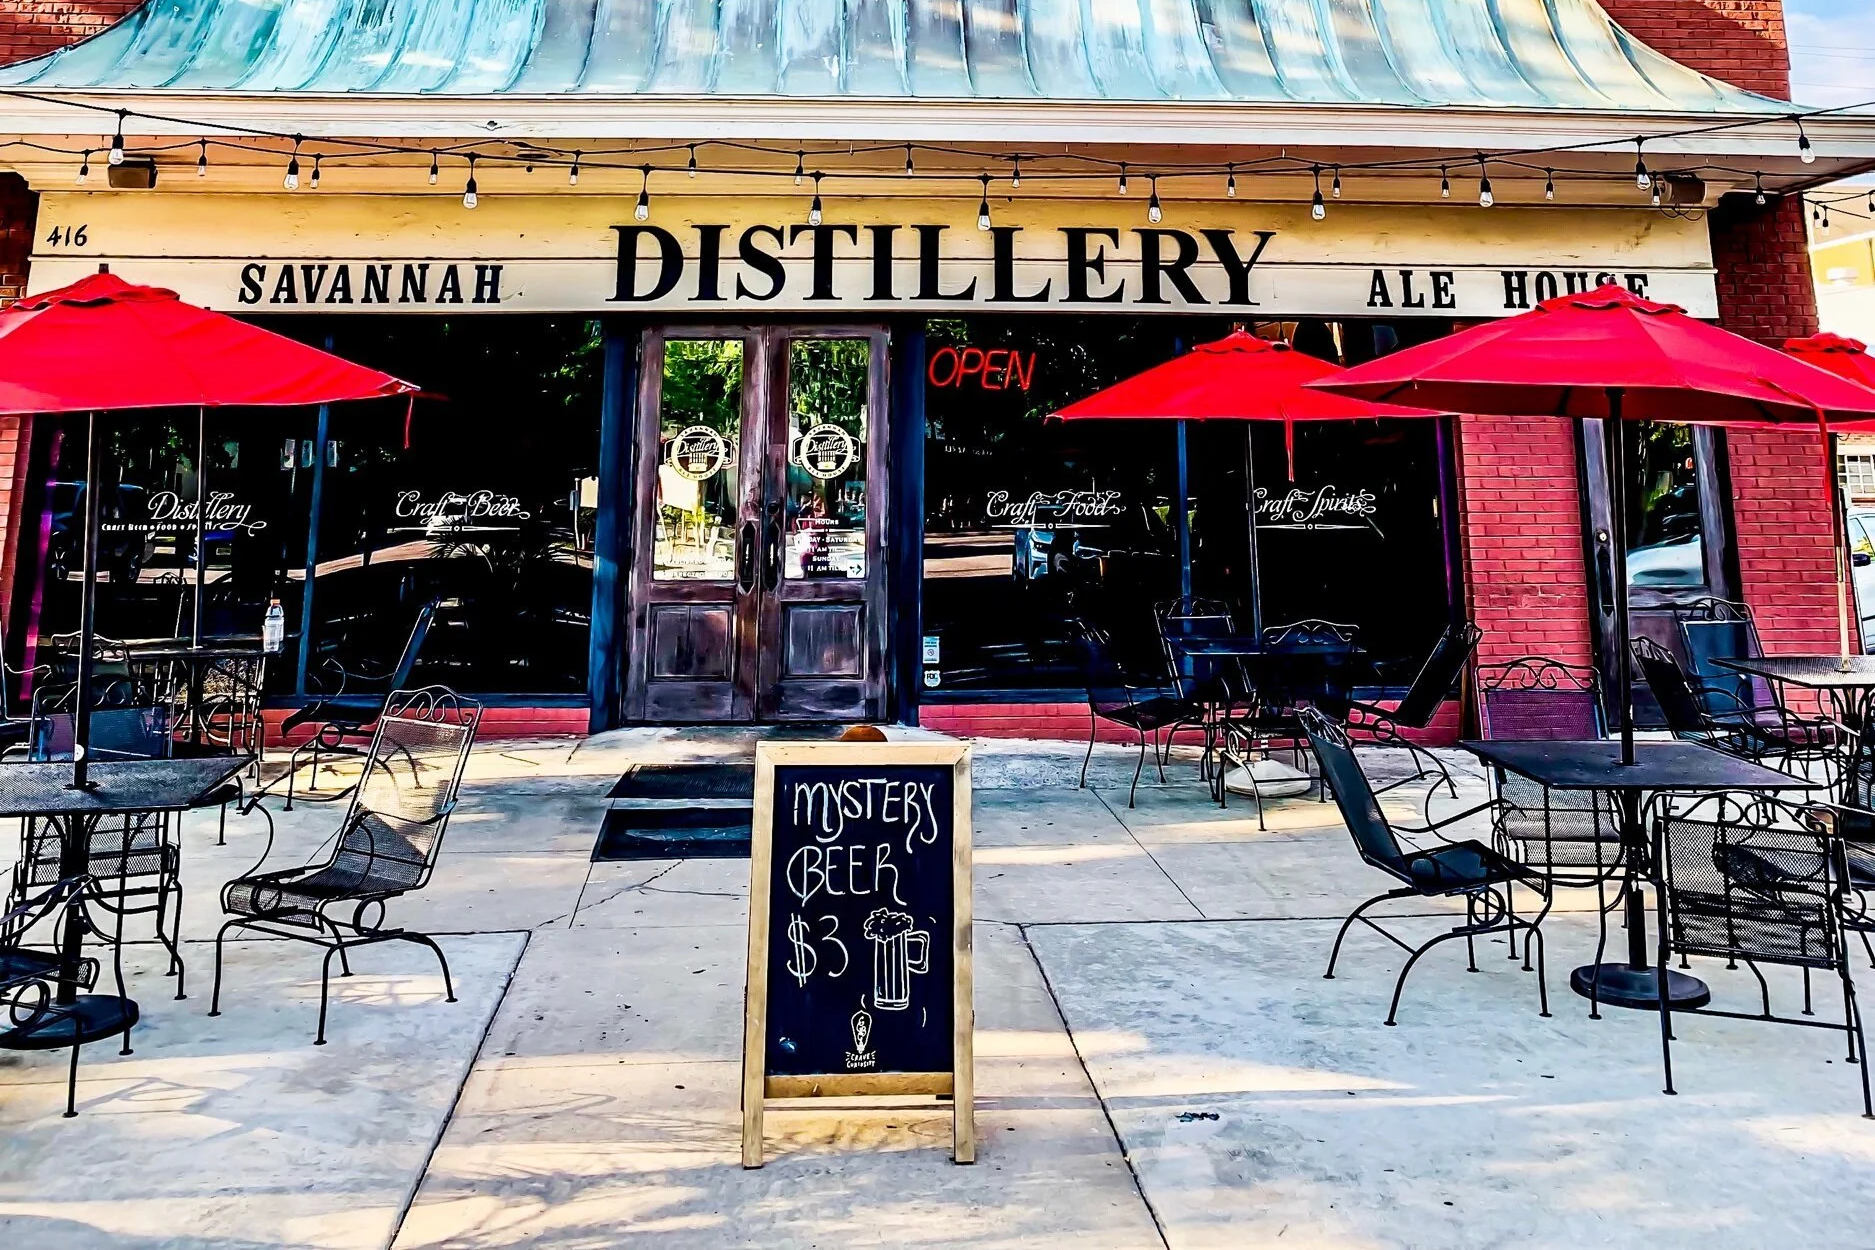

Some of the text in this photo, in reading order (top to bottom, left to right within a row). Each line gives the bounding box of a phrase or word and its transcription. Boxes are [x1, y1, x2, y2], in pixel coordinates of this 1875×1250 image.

[46, 224, 88, 247] 416
[238, 263, 504, 305] SAVANNAH
[605, 224, 1277, 307] DISTILLERY
[1367, 269, 1456, 309] ALE
[928, 347, 1037, 391] OPEN
[395, 490, 467, 525] Craft
[986, 489, 1126, 525] Craft Food
[1292, 485, 1377, 522] Spirits
[793, 779, 938, 854] MYSTERY
[787, 843, 907, 907] BEER
[787, 912, 849, 988] $3
